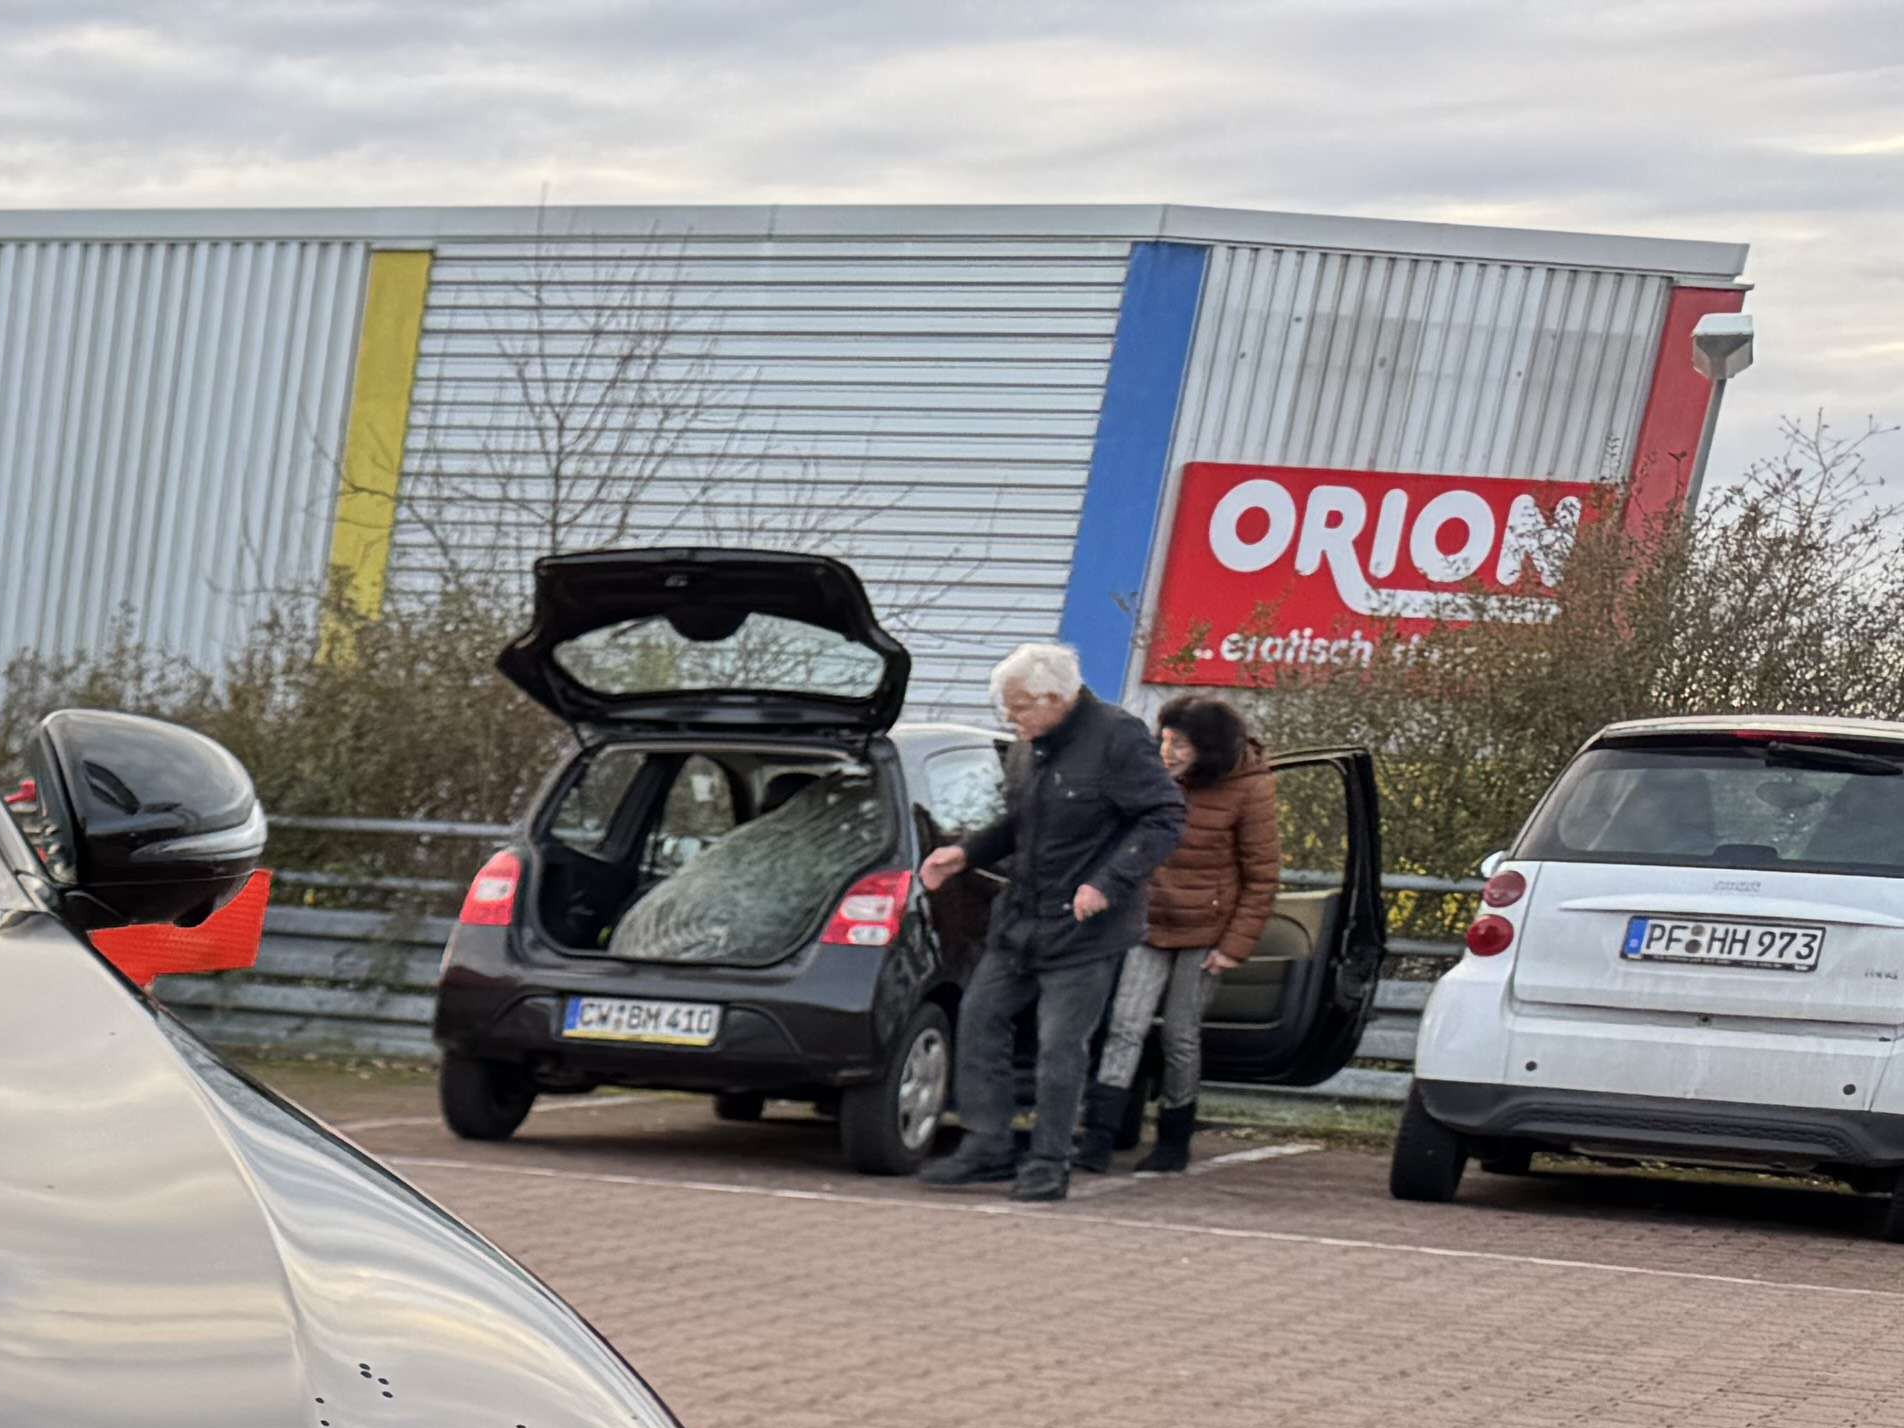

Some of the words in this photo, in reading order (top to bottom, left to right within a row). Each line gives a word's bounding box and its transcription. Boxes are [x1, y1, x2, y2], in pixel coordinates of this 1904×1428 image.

[1209, 479, 1582, 620] ORION
[1645, 923, 1688, 952] PF
[1706, 927, 1752, 957] HH
[1758, 931, 1819, 960] 973
[627, 1005, 662, 1030] BM
